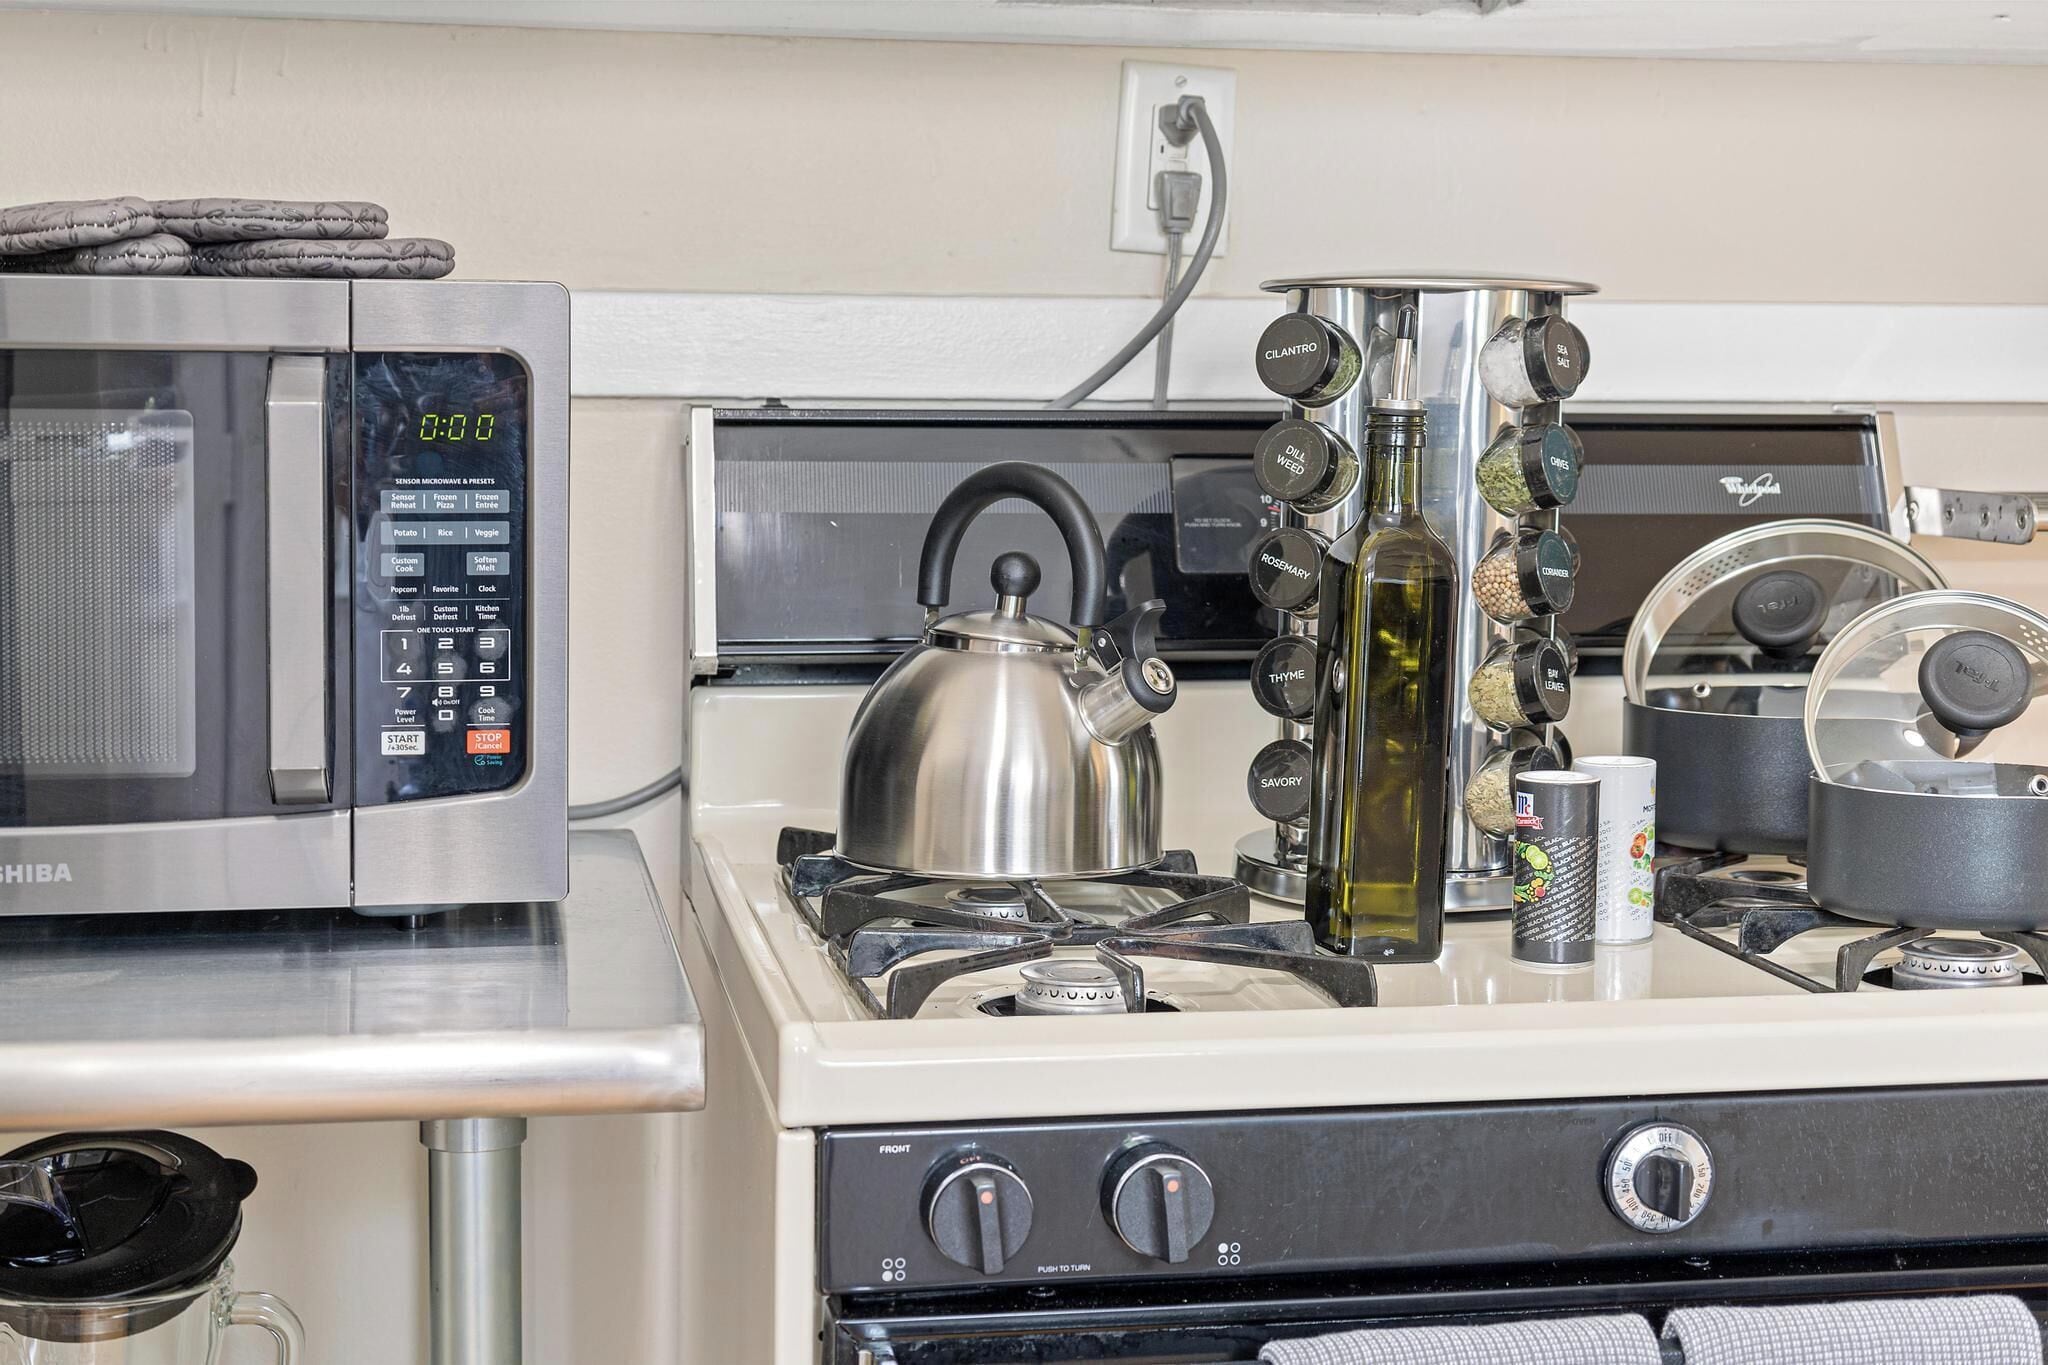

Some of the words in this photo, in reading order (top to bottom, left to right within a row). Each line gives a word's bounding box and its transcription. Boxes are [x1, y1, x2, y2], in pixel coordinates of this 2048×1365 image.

[1265, 342, 1317, 360] CILANTRO
[1557, 344, 1568, 356] SEA
[1557, 356, 1570, 368] SALT
[420, 414, 495, 440] 0:00
[1286, 445, 1305, 462] DILL
[1276, 454, 1304, 475] WEED
[1551, 456, 1569, 470] CHIVES
[1260, 495, 1272, 504] 10
[1260, 518, 1267, 527] 9
[474, 528, 499, 538] Veggie
[1261, 553, 1310, 580] ROSEMARY
[1542, 567, 1569, 578] CORIANDER
[391, 586, 417, 594] Popcorn
[401, 638, 408, 650] 1
[438, 638, 454, 649] 2
[480, 638, 495, 649] 3
[396, 663, 412, 675] 4
[438, 663, 453, 674] 5
[480, 662, 495, 673] 6
[1548, 668, 1559, 678] BAY
[1269, 670, 1305, 684] THYME
[438, 686, 453, 697] 8
[480, 686, 495, 697] 9
[1544, 680, 1564, 692] LEAVES
[396, 687, 412, 698] 7
[438, 710, 453, 720] 0
[387, 735, 419, 743] START
[476, 734, 502, 742] STOP
[1260, 776, 1302, 788] SAVORY
[0, 863, 72, 883] HIBA
[1659, 1133, 1672, 1143] OFF
[879, 1144, 911, 1153] FRONT
[1697, 1162, 1706, 1178] 150
[1621, 1179, 1630, 1193] 450
[1693, 1183, 1705, 1198] 200
[1626, 1197, 1638, 1212] 400
[1641, 1211, 1656, 1222] 350
